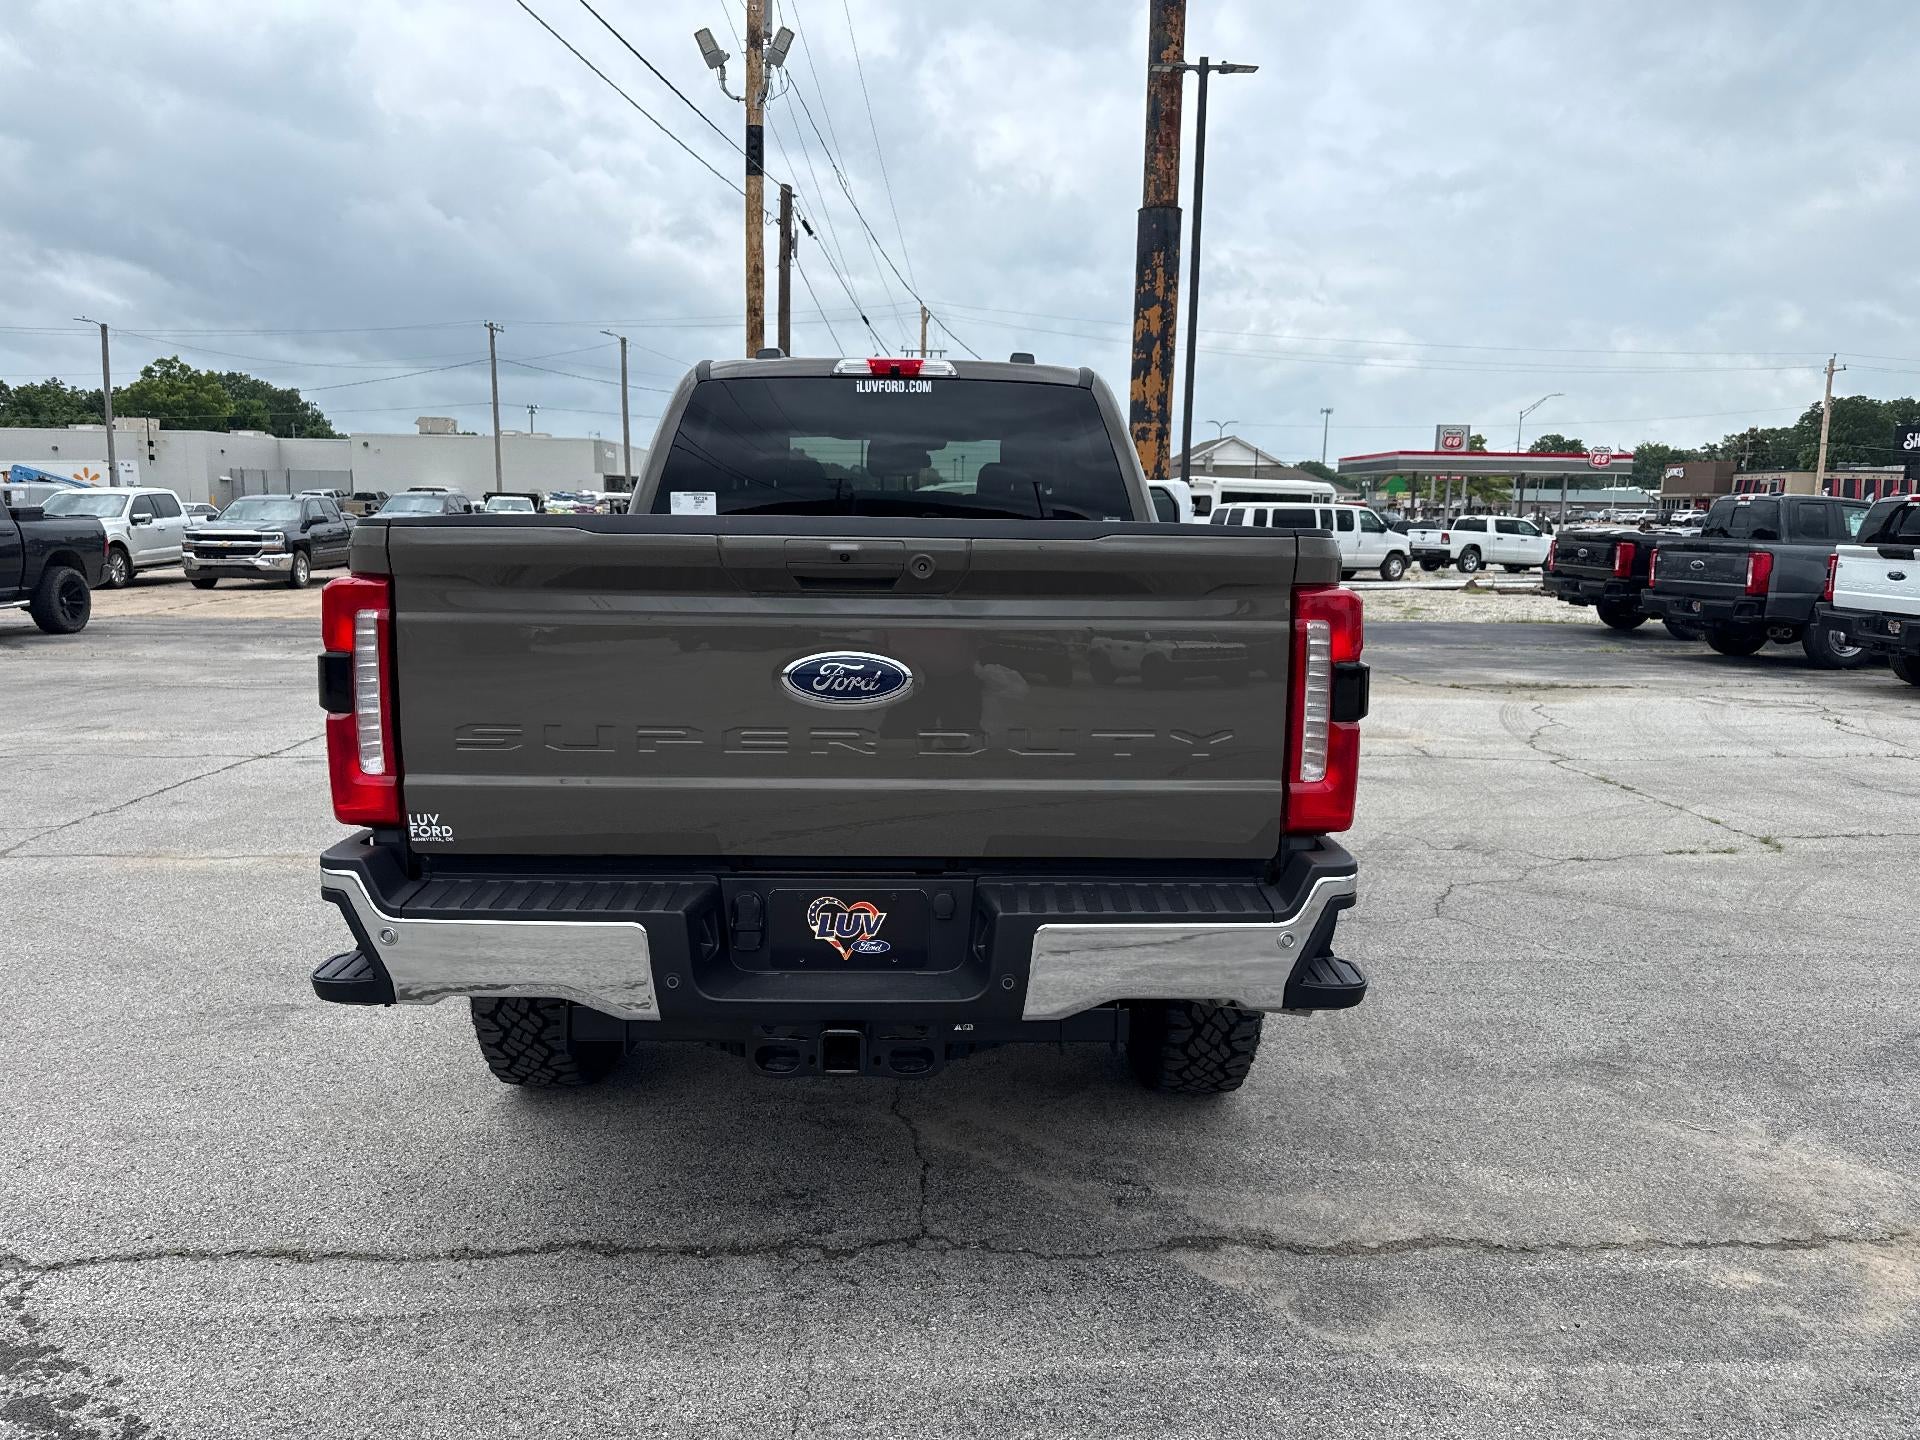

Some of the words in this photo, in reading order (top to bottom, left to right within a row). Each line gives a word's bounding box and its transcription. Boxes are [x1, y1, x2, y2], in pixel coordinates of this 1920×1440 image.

[856, 380, 932, 393] iLUVFORD.COM
[1445, 437, 1460, 446] 66
[1594, 454, 1609, 464] 66
[812, 662, 882, 691] Ford
[454, 723, 876, 754] SUPER
[915, 727, 1234, 757] DUTY
[408, 814, 439, 825] LUV
[410, 826, 453, 837] FORD
[815, 913, 887, 940] LUV
[857, 940, 883, 952] Ford
